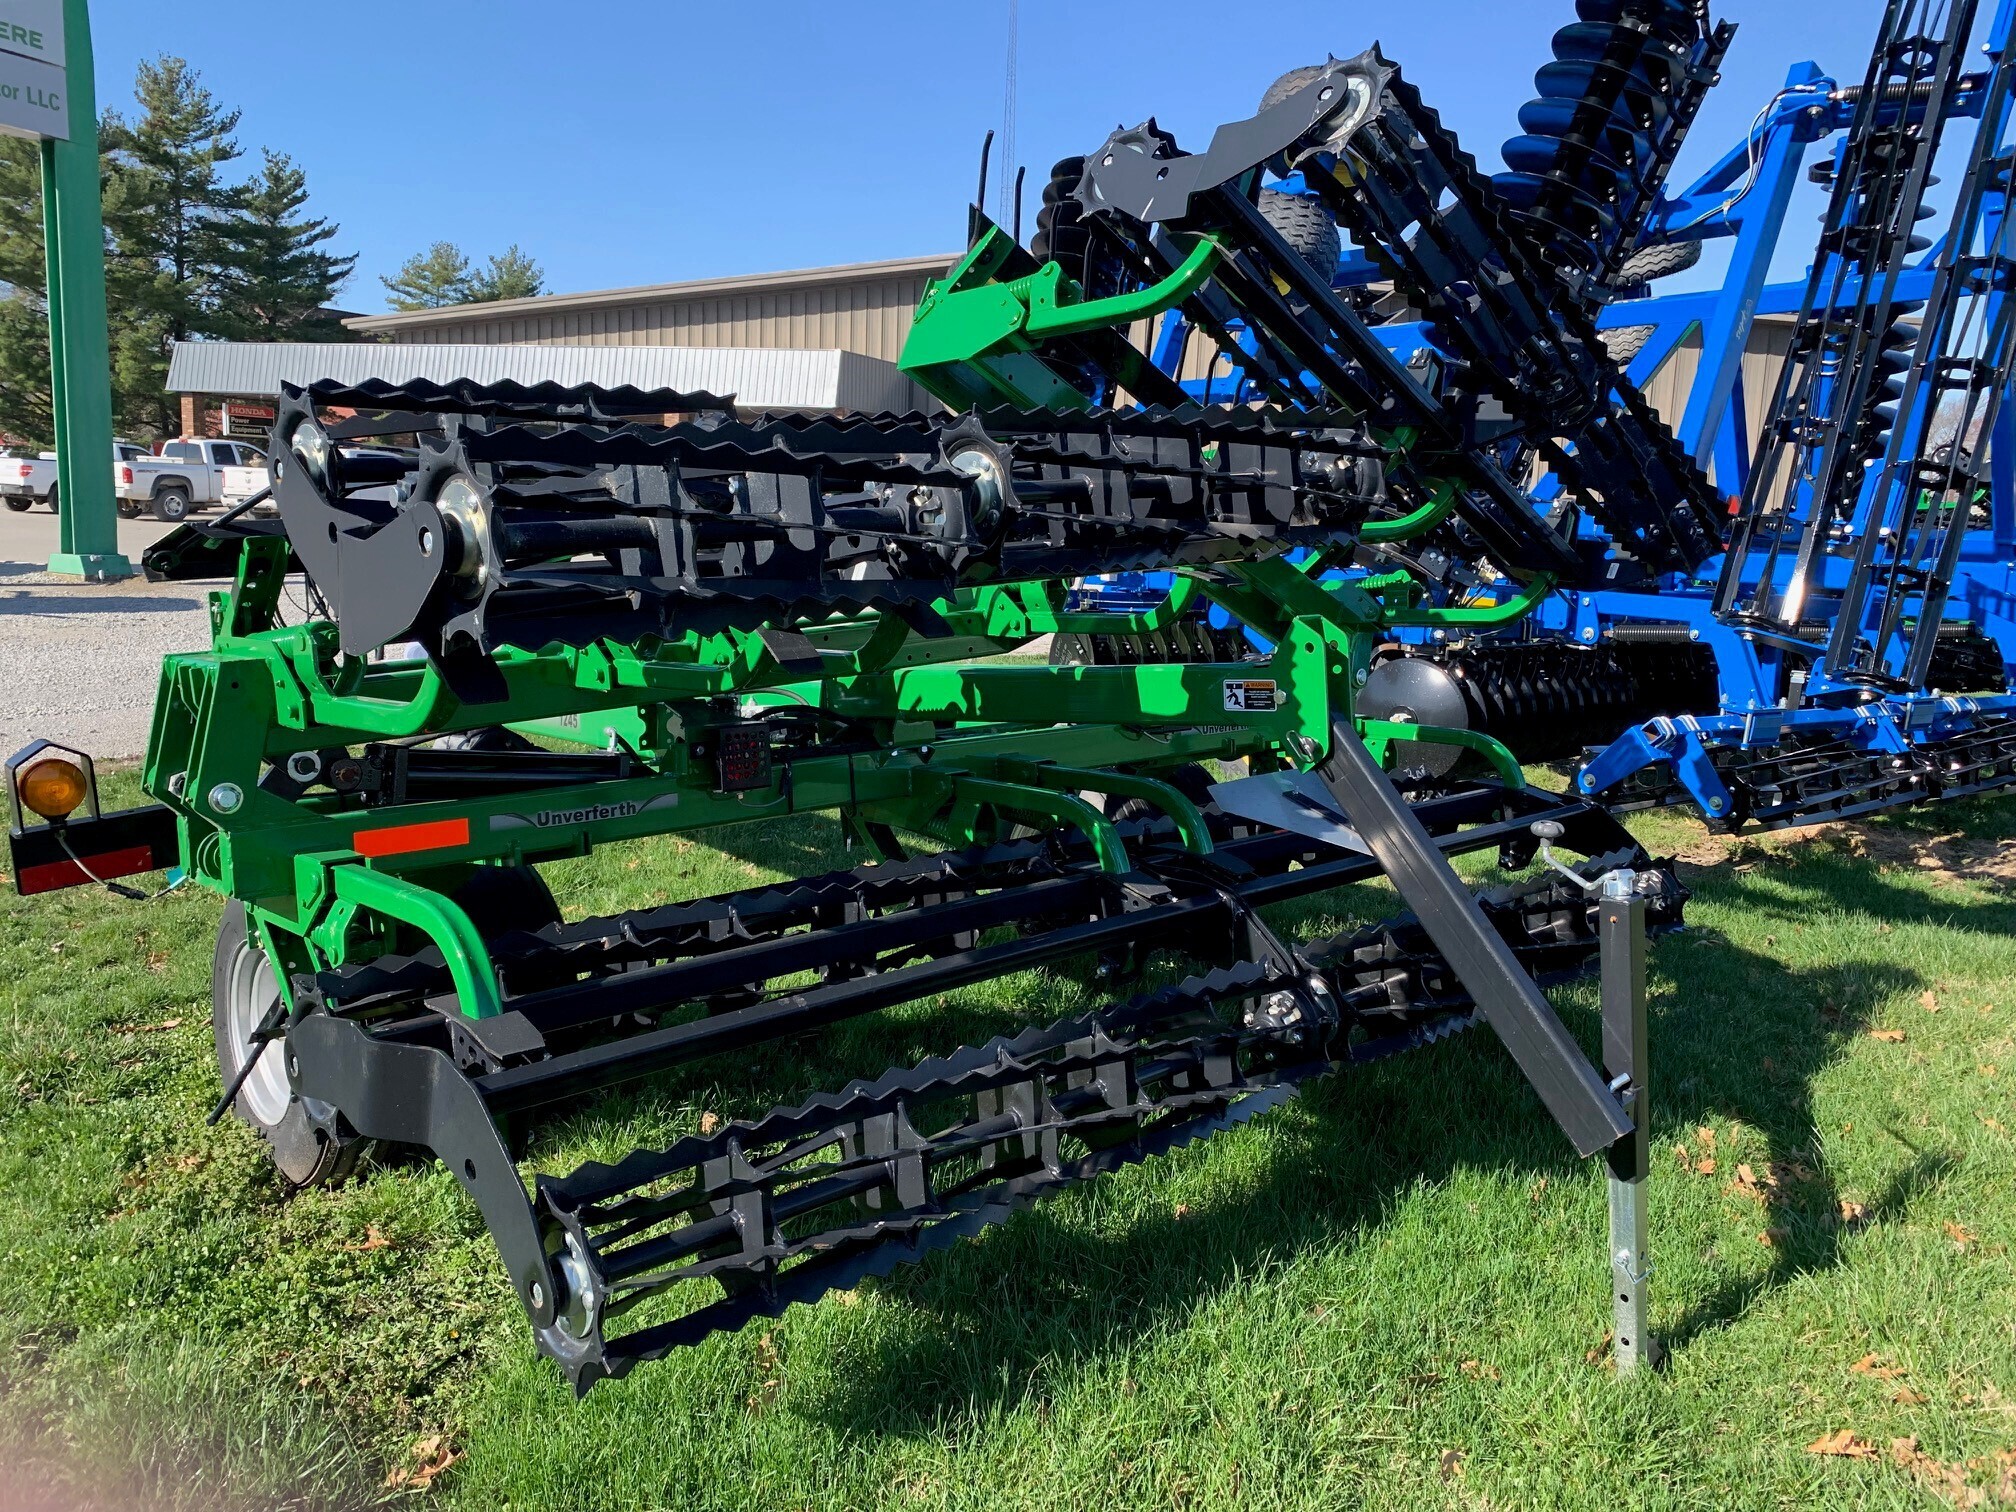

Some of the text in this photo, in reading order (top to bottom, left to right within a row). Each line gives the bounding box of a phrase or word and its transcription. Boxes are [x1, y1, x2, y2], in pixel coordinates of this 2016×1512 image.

[0, 84, 60, 112] or LLC
[230, 406, 266, 416] HONDA
[230, 416, 250, 424] Power
[231, 425, 263, 434] Equipment
[560, 714, 578, 729] 1245
[537, 802, 637, 827] Unverferth
